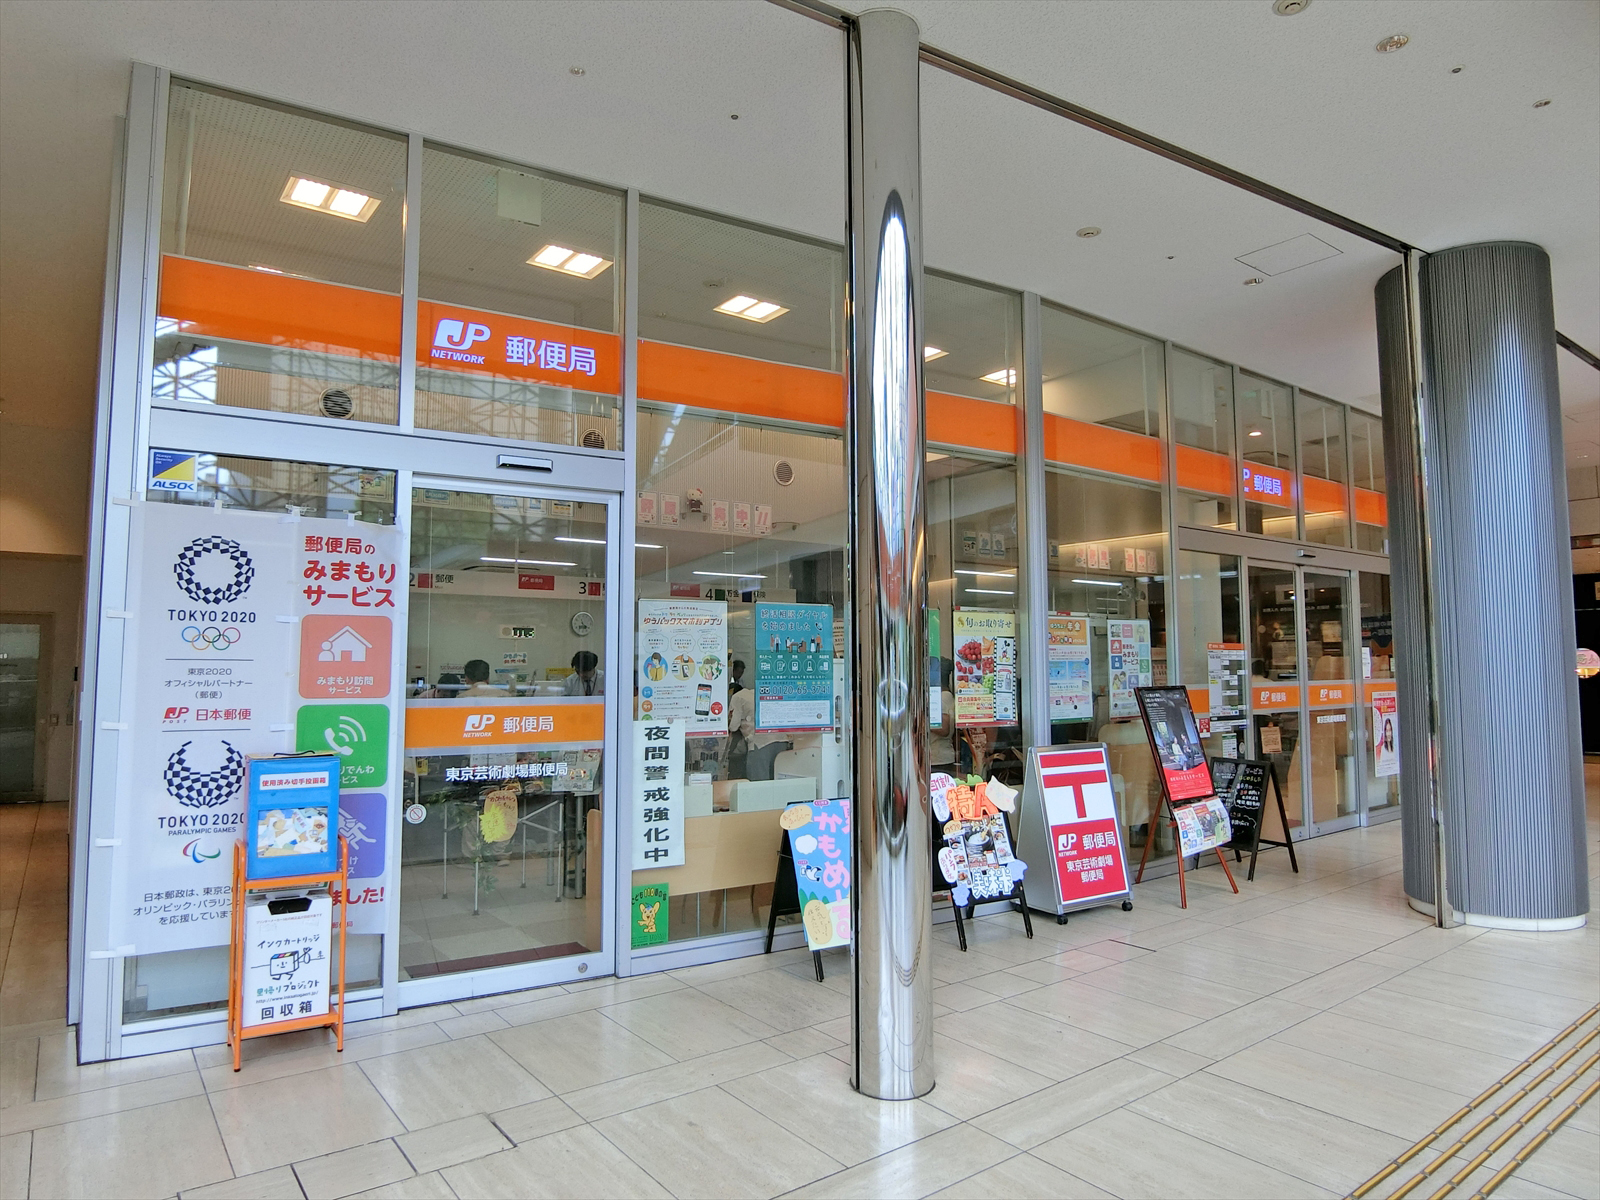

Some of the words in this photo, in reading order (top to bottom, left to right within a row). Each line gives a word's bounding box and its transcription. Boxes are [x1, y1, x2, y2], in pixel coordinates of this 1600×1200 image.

[431, 348, 486, 365] NETWORK
[505, 335, 597, 377] 郵便局
[152, 480, 195, 491] ALSOK
[1253, 474, 1282, 497] 郵便局
[304, 535, 376, 555] 郵便局の
[303, 559, 396, 584] みまもり
[435, 574, 454, 584] 郵便
[578, 581, 587, 595] 3
[705, 588, 713, 600] 4
[302, 585, 396, 608] サービス
[168, 609, 218, 622] TOKYO
[221, 611, 257, 623] 2020
[760, 609, 828, 620] 終活相談ダイヤル
[965, 616, 1013, 628] 旬のお取り寄せ
[761, 621, 811, 632] を始めました
[187, 667, 233, 676] 東京2020
[164, 679, 253, 688] オフィシャルパートナー
[316, 675, 375, 686] みまもり訪問
[194, 690, 224, 700] （郵便）
[328, 686, 362, 694] サービス
[771, 685, 831, 695] 0120-65-3741
[195, 708, 252, 721] 日本郵便
[503, 715, 554, 733] 郵便局
[445, 762, 568, 782] 東京芸術劇場郵便局
[643, 725, 670, 863] 夜間警戒強化中
[158, 814, 209, 829] TOKYO
[168, 828, 212, 836] PARALYMPIC
[1082, 831, 1117, 850] 郵便局
[1065, 854, 1114, 872] 東京芸術劇場
[1080, 868, 1105, 883] 郵便局
[159, 910, 233, 926] を応援していま
[257, 933, 321, 949] インクカートリッジ
[256, 980, 320, 997] 里帰りプロジェクト
[261, 1000, 313, 1021] 回収箱
